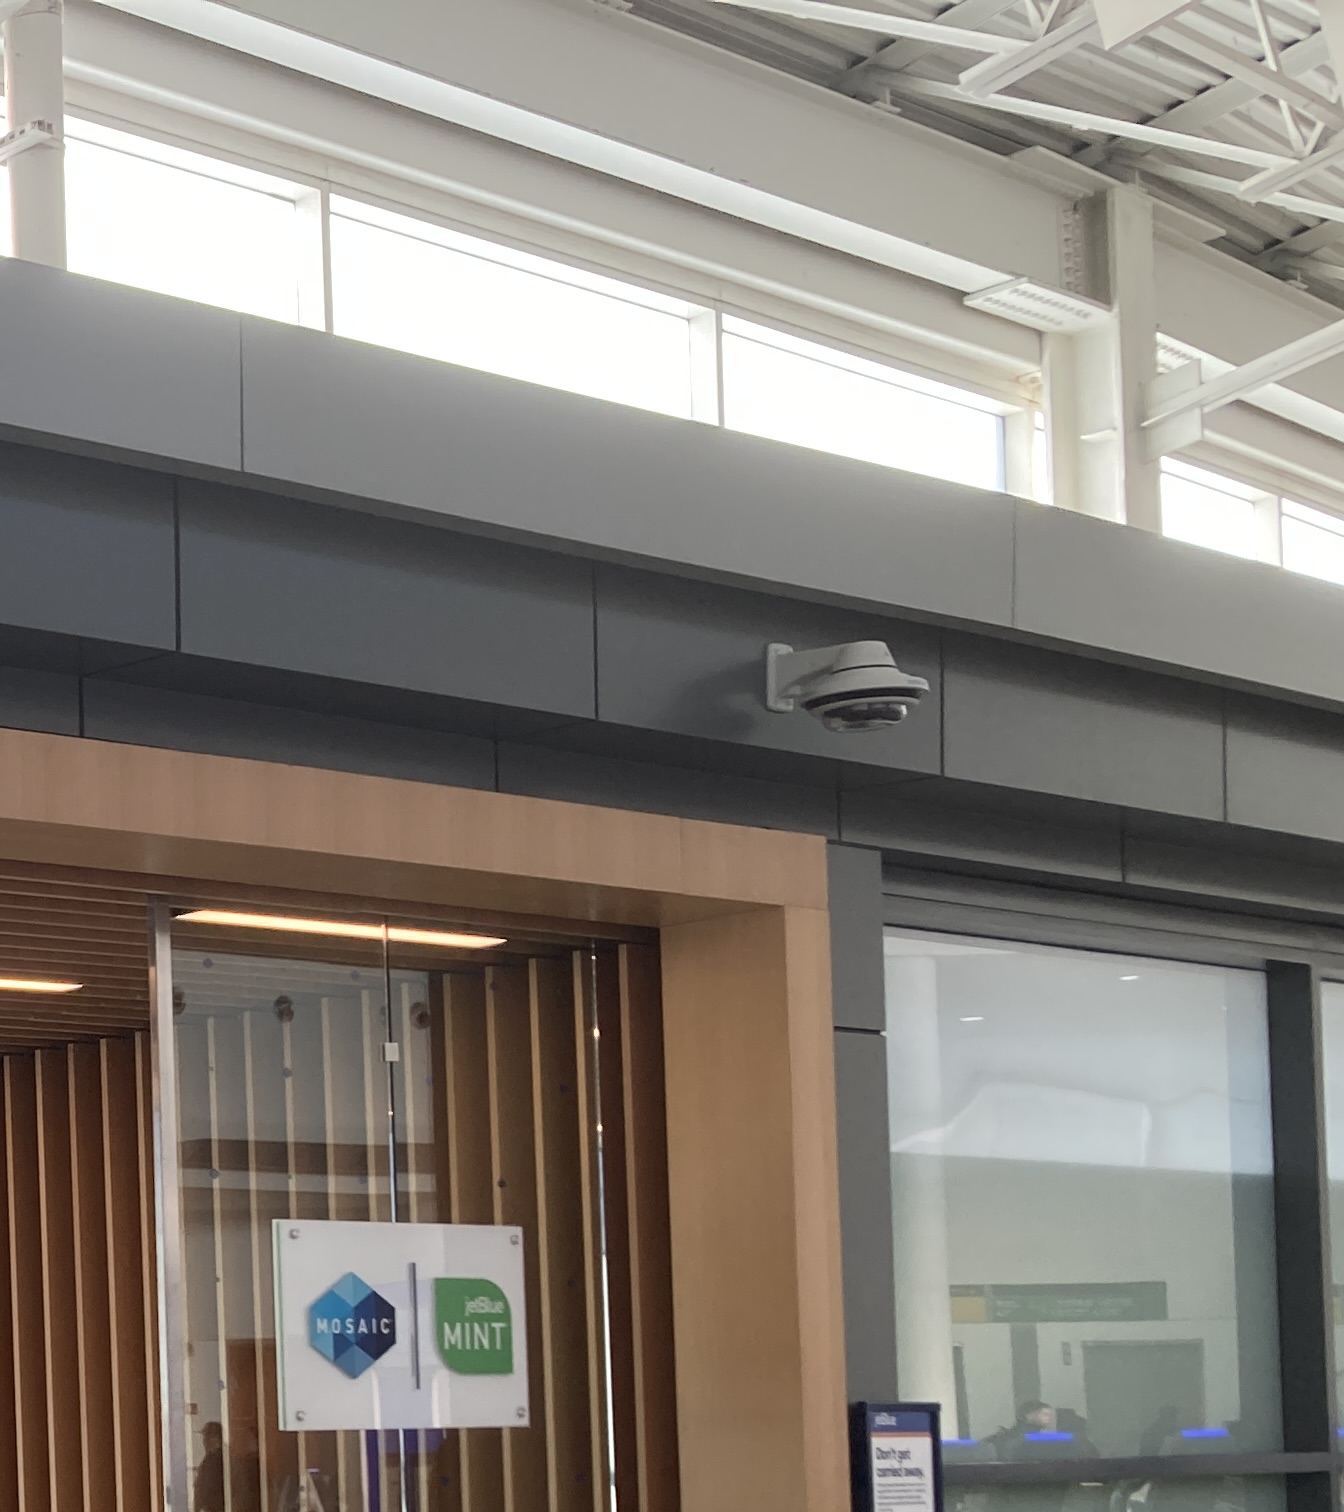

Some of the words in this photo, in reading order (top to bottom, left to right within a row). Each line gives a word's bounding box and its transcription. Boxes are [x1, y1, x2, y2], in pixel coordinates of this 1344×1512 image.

[465, 1296, 504, 1317] jetBlue
[316, 1317, 391, 1335] MOSAIC
[443, 1322, 506, 1350] MINT
